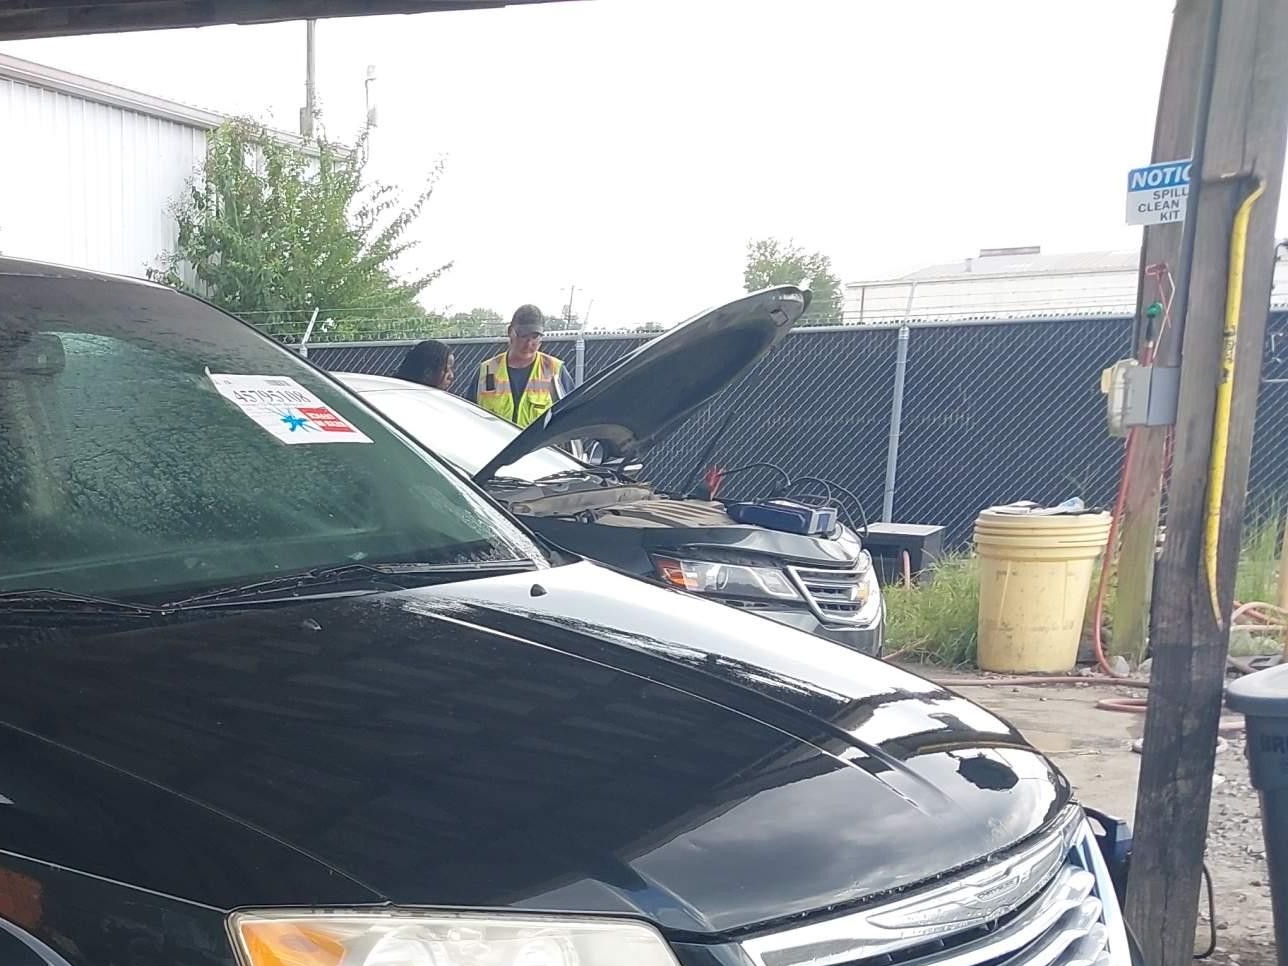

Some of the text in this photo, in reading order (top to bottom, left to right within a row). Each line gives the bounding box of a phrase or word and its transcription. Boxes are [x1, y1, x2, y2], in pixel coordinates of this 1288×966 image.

[1153, 188, 1189, 200] SPILL
[1137, 199, 1180, 213] CLEAN
[1160, 210, 1181, 221] KIT
[232, 389, 312, 403] 45795108
